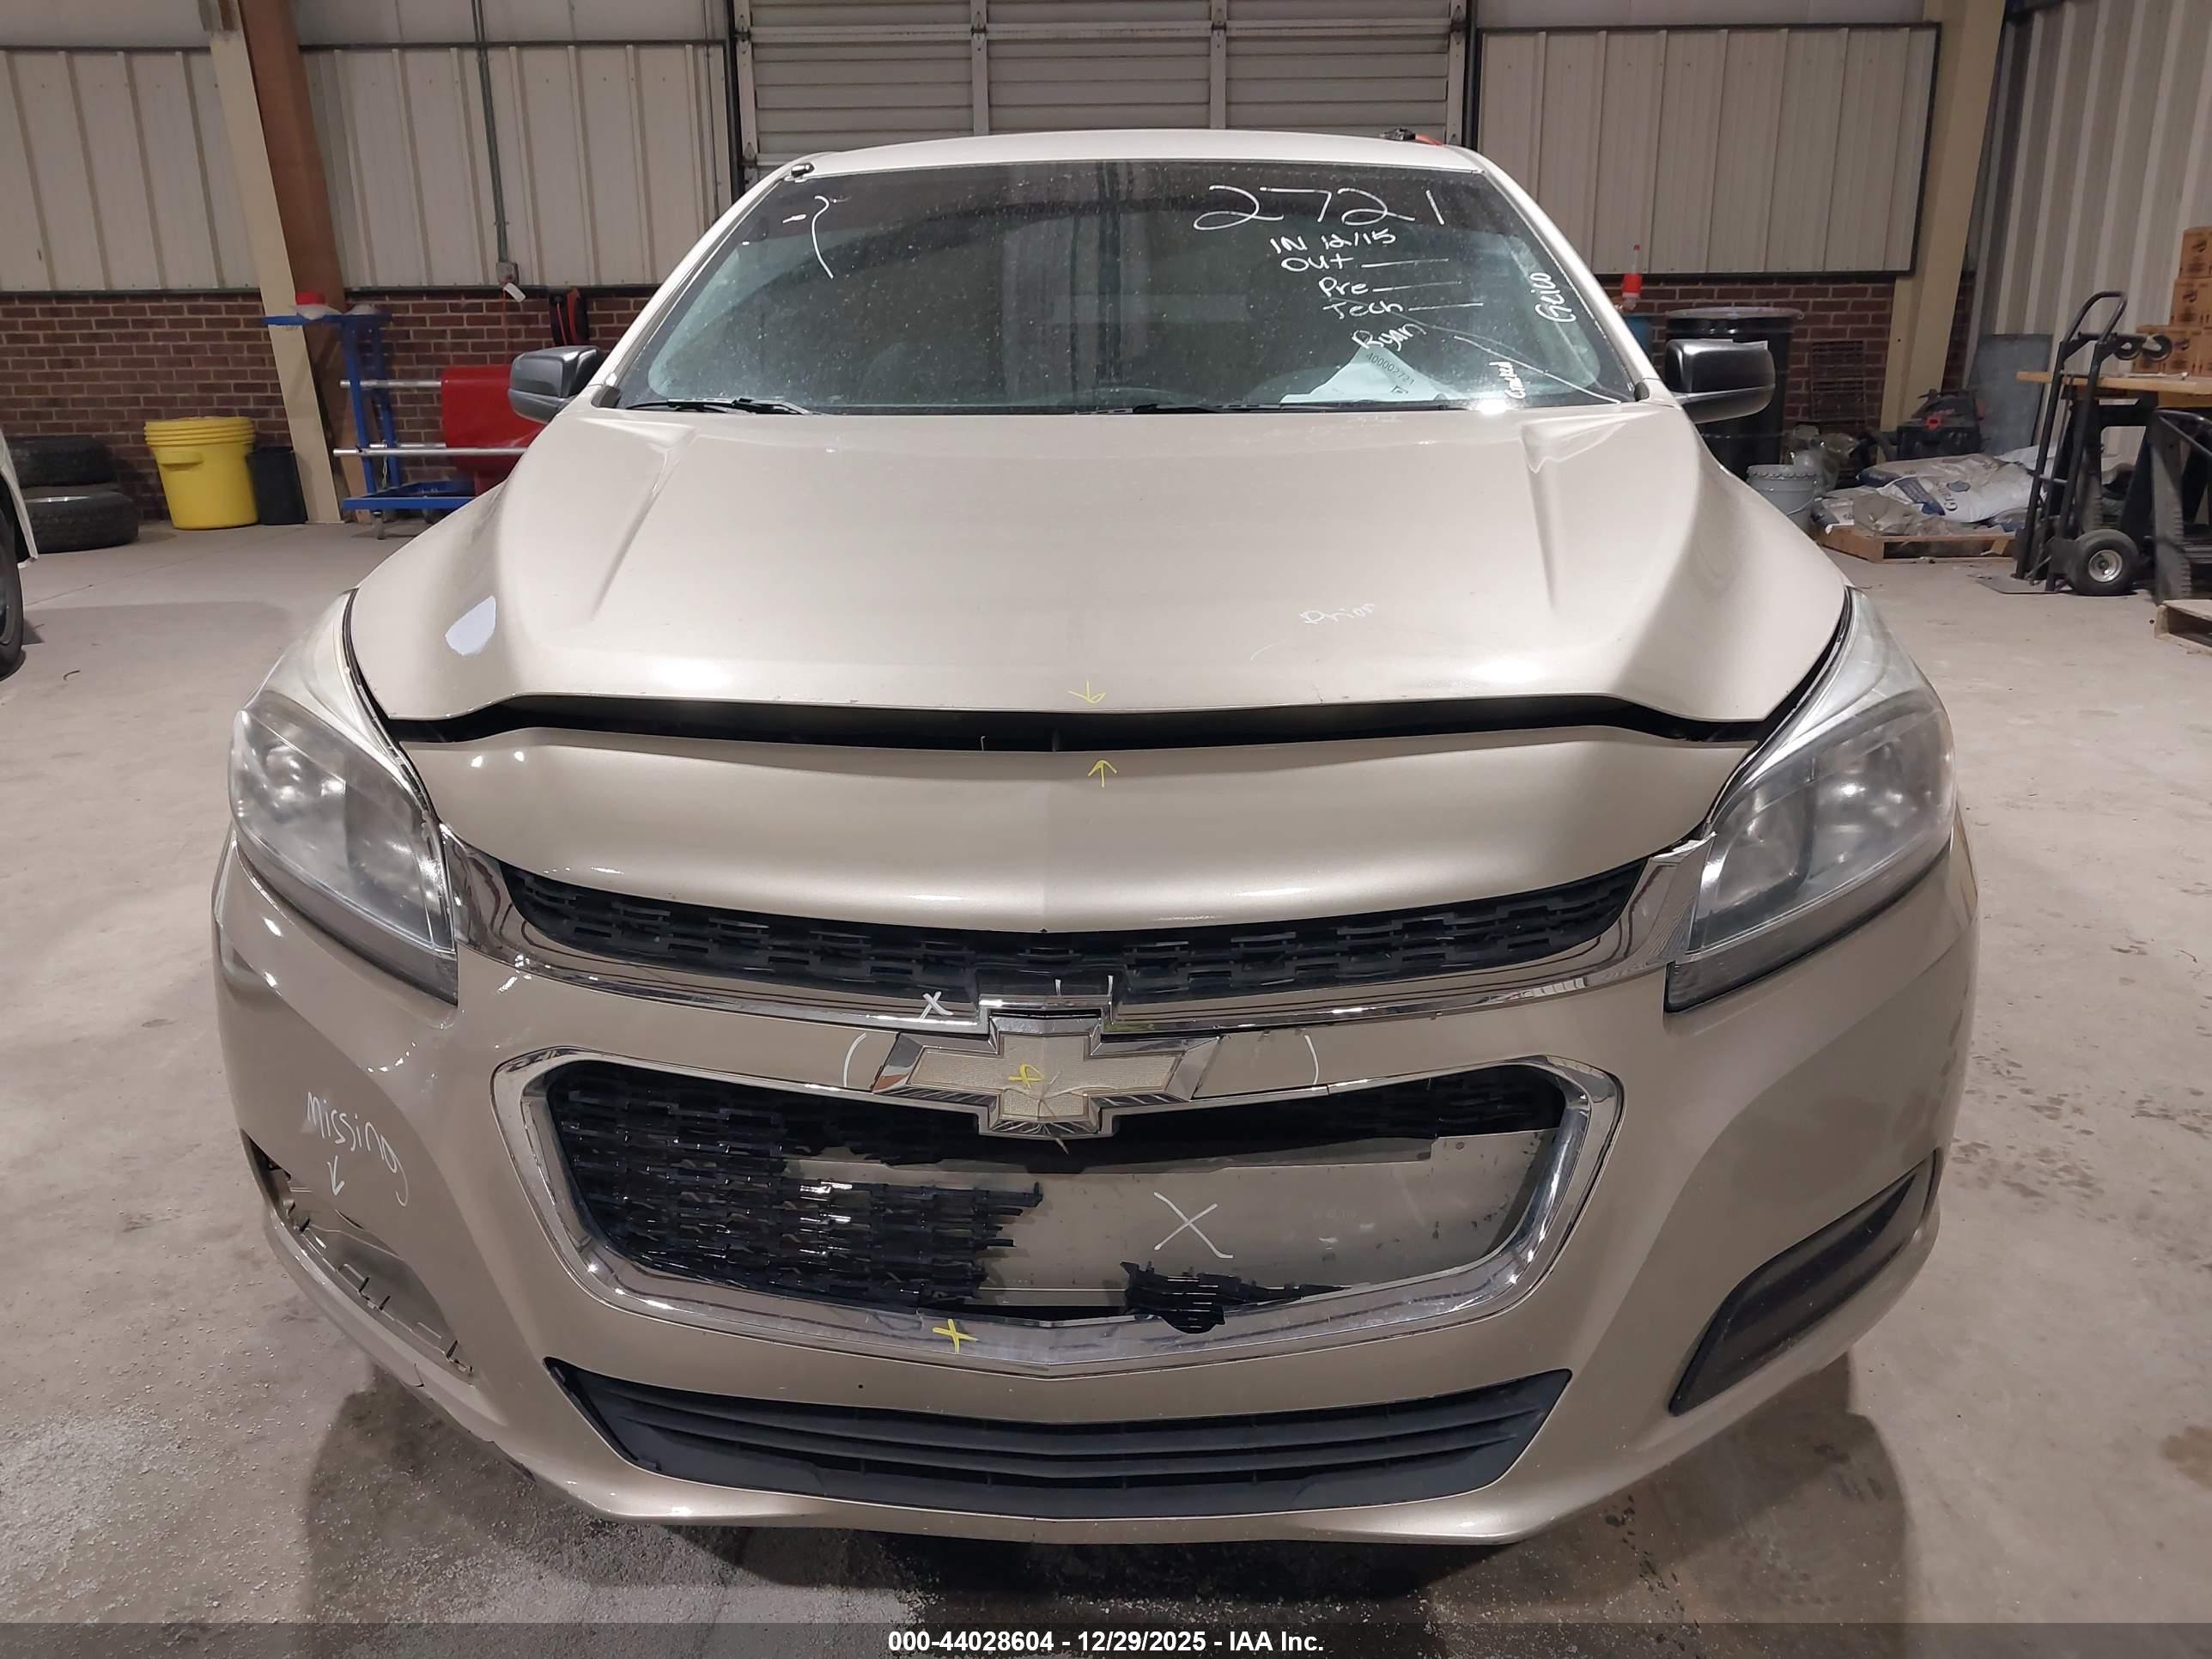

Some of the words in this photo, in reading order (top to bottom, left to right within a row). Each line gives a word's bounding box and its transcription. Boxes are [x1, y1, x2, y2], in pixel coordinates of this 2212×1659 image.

[1193, 185, 1445, 230] 2721
[1270, 235, 1308, 254] IN
[1321, 228, 1397, 250] 12/15
[1318, 276, 1370, 298] Pre
